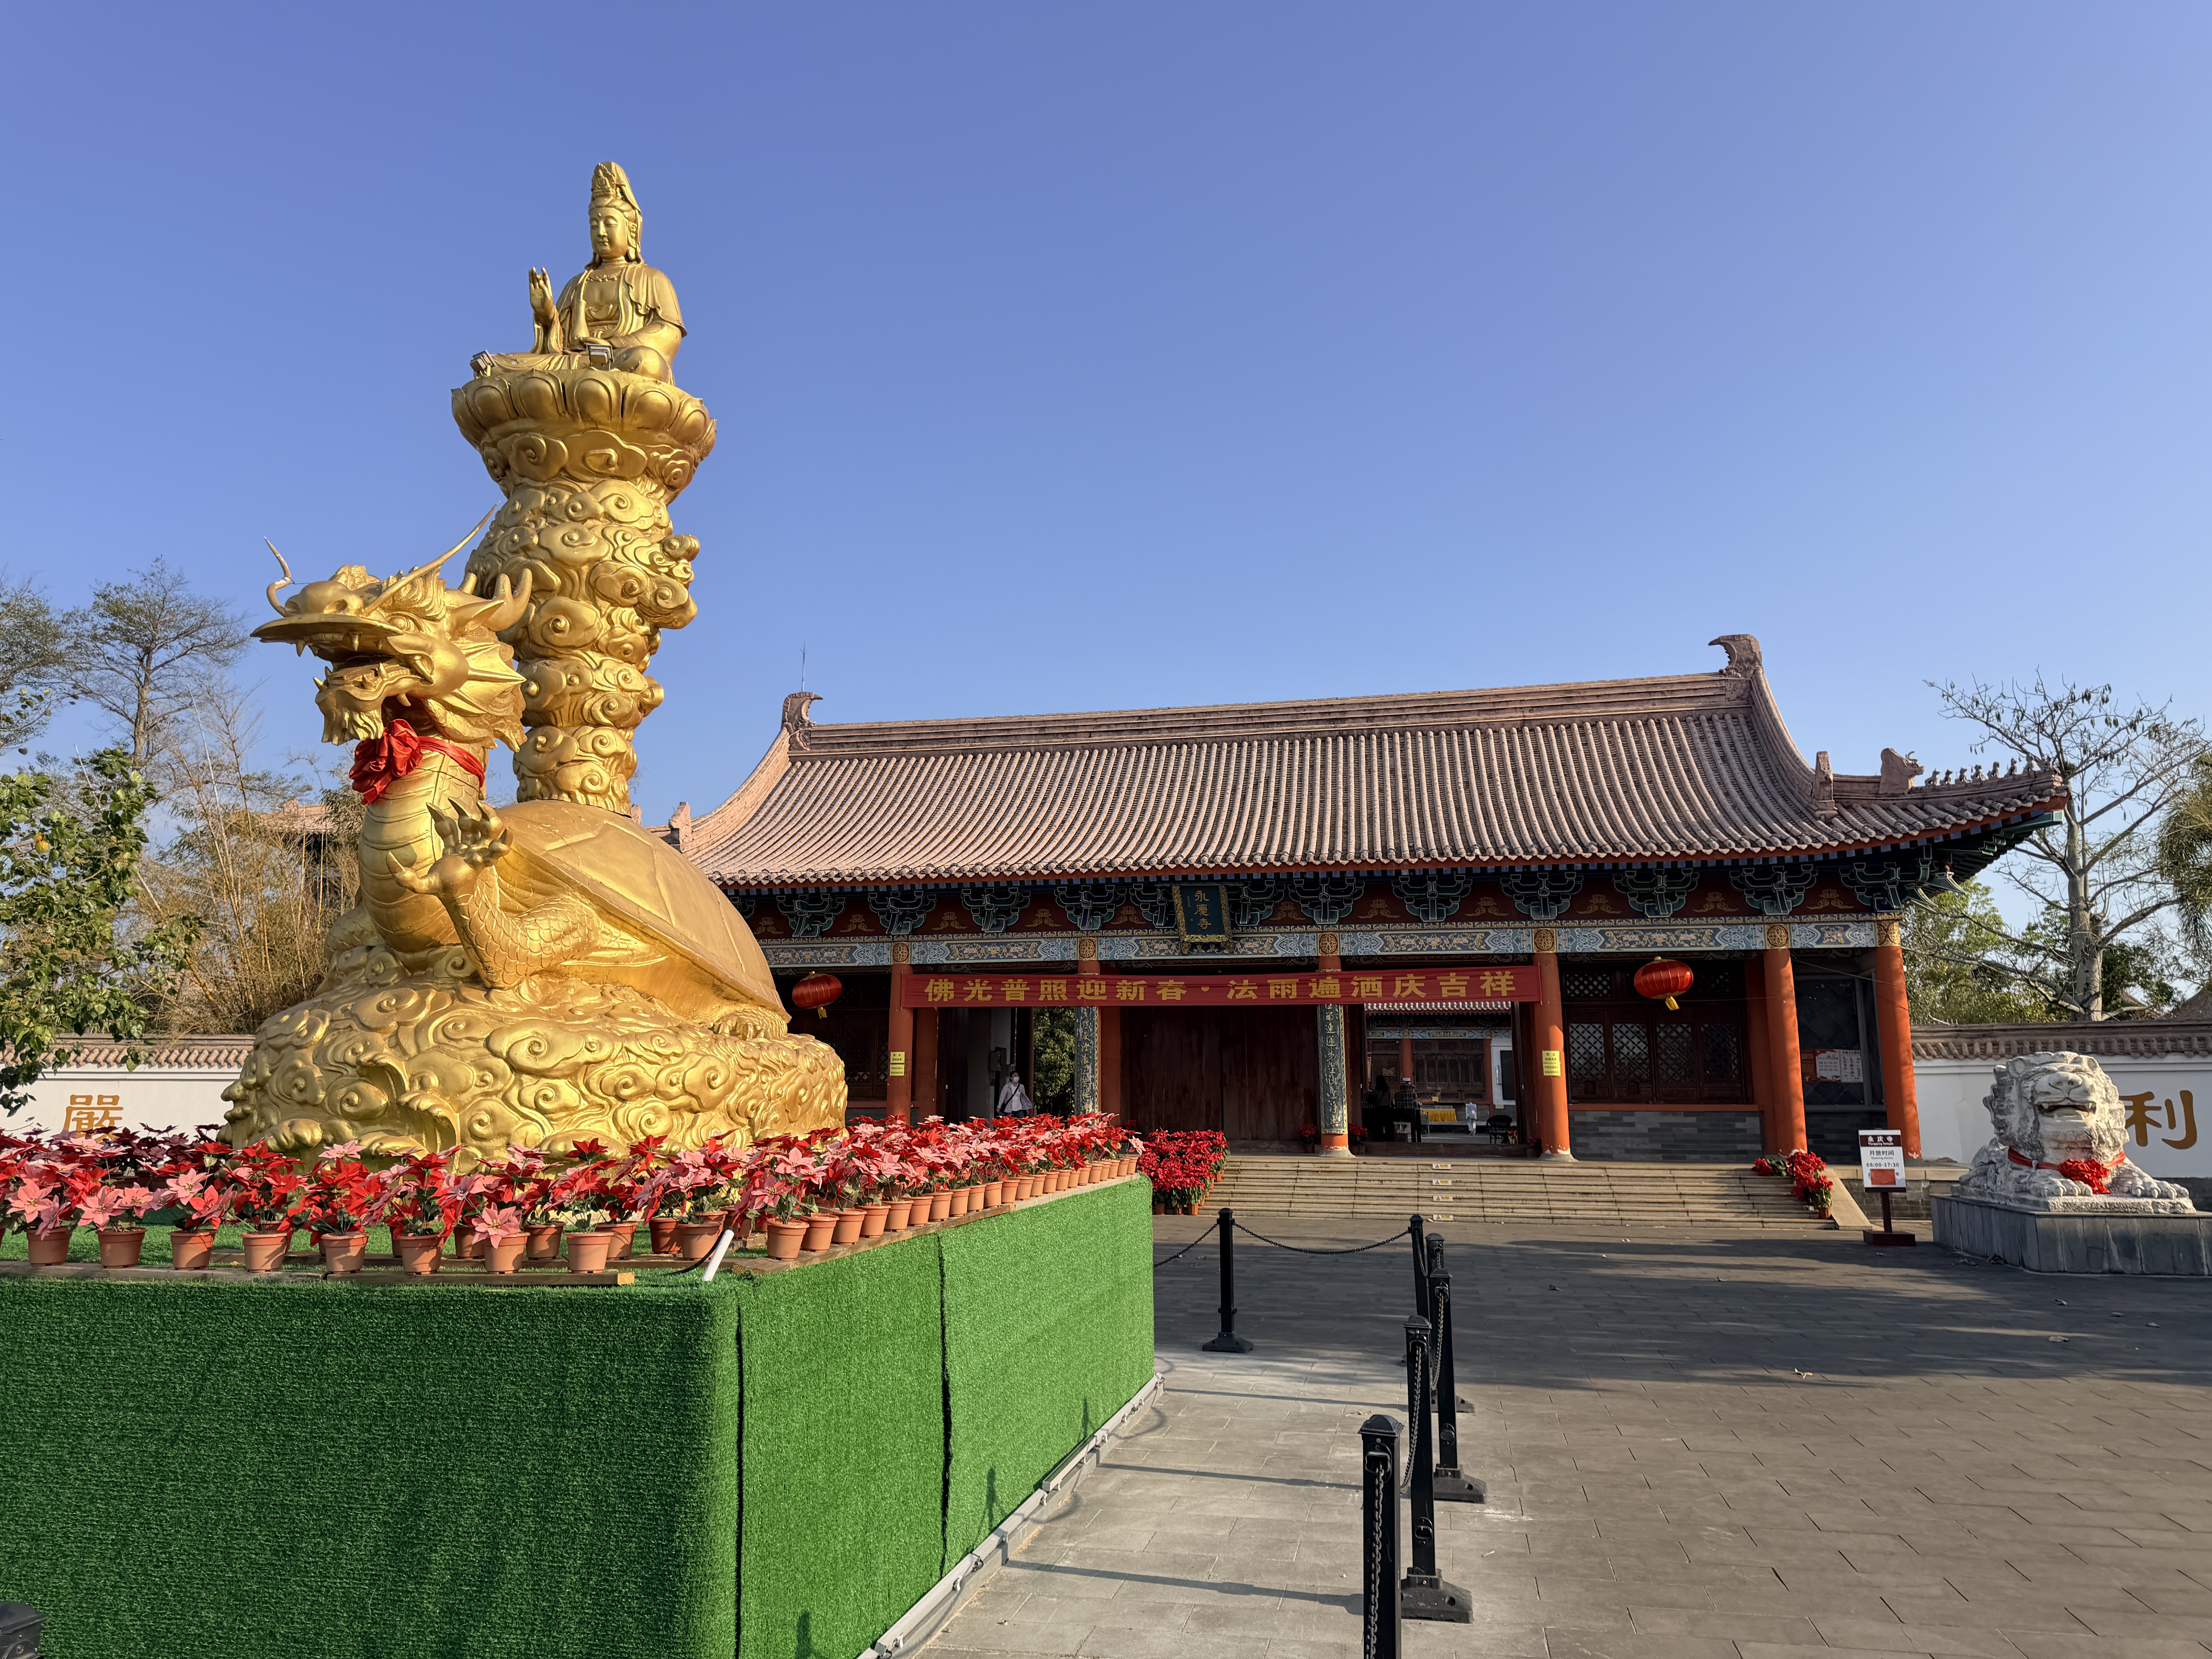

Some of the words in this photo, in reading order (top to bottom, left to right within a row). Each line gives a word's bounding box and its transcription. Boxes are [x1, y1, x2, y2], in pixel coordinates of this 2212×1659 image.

[1194, 890, 1211, 929] 永慶寺
[63, 1094, 124, 1143] 嚴
[2119, 1090, 2197, 1149] 利
